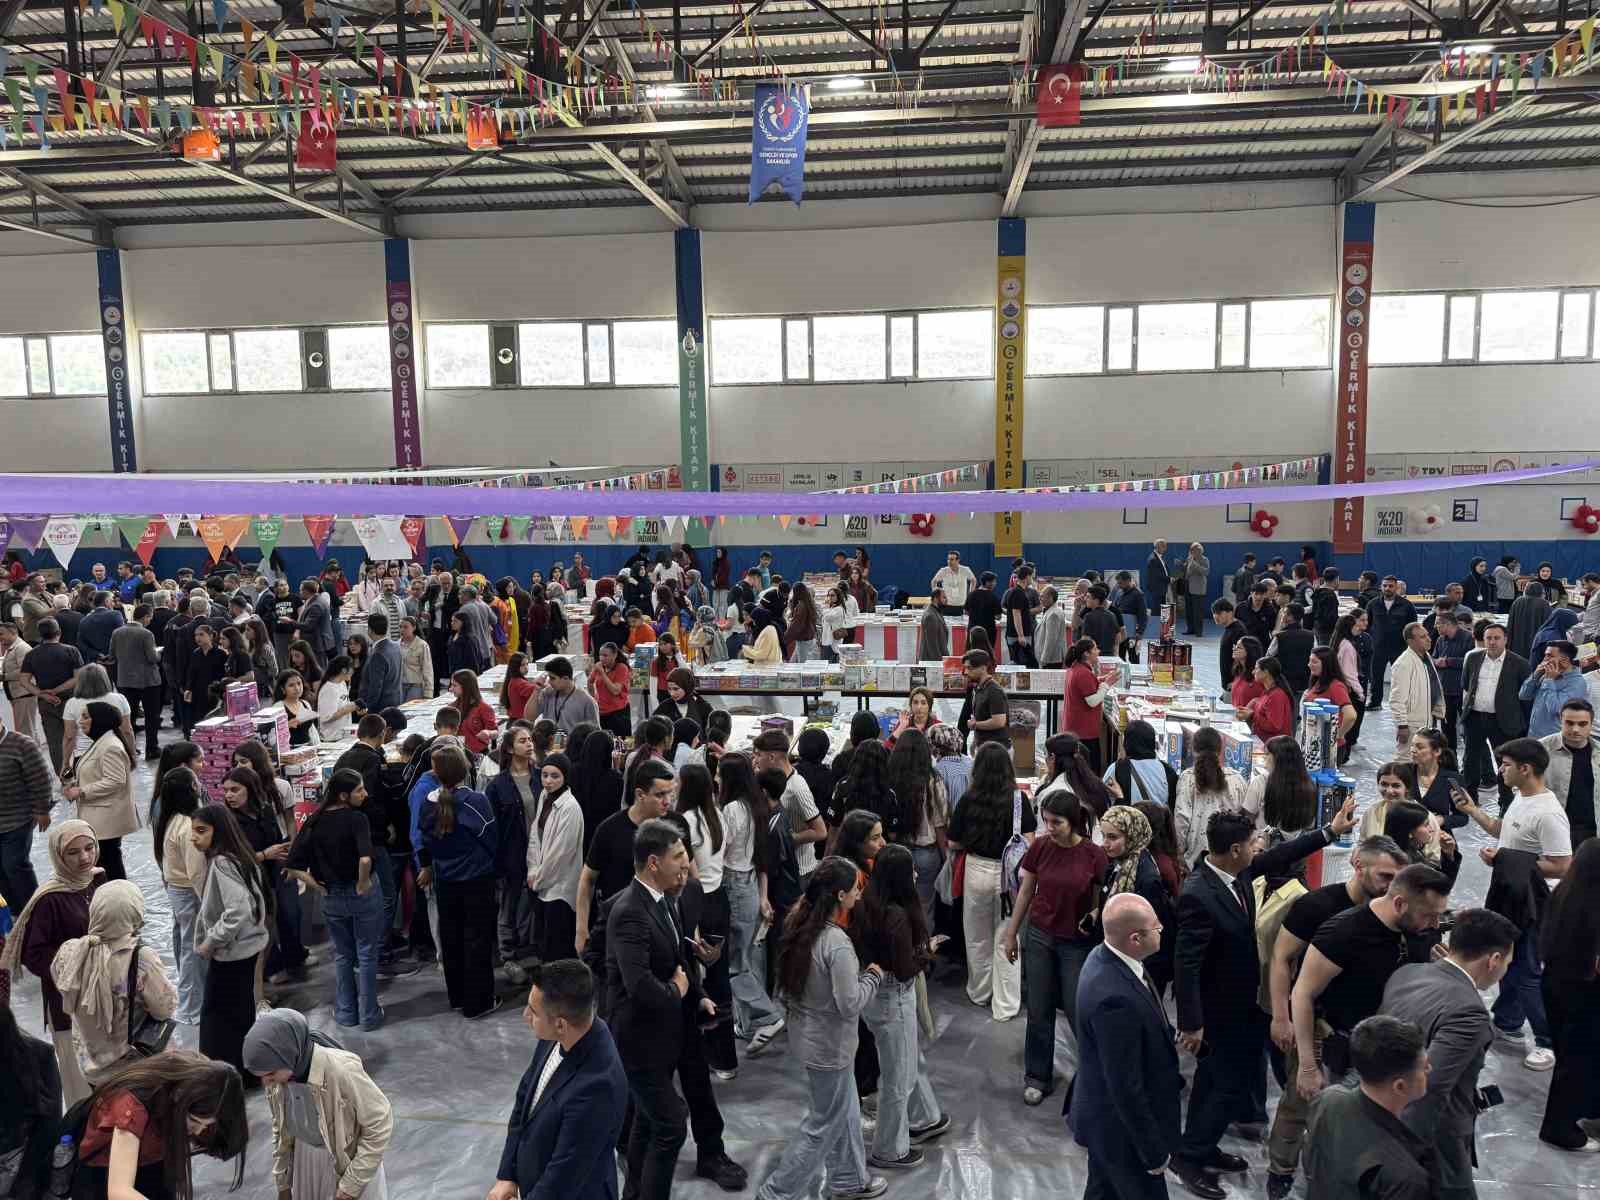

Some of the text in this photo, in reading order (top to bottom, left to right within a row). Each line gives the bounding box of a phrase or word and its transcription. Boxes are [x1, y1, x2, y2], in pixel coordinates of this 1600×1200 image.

[1348, 350, 1360, 413] ÇERMİK
[1004, 430, 1013, 479] KİTAP
[1346, 421, 1355, 472] KİTAP
[1422, 466, 1444, 475] TDV
[1377, 511, 1403, 526] %20
